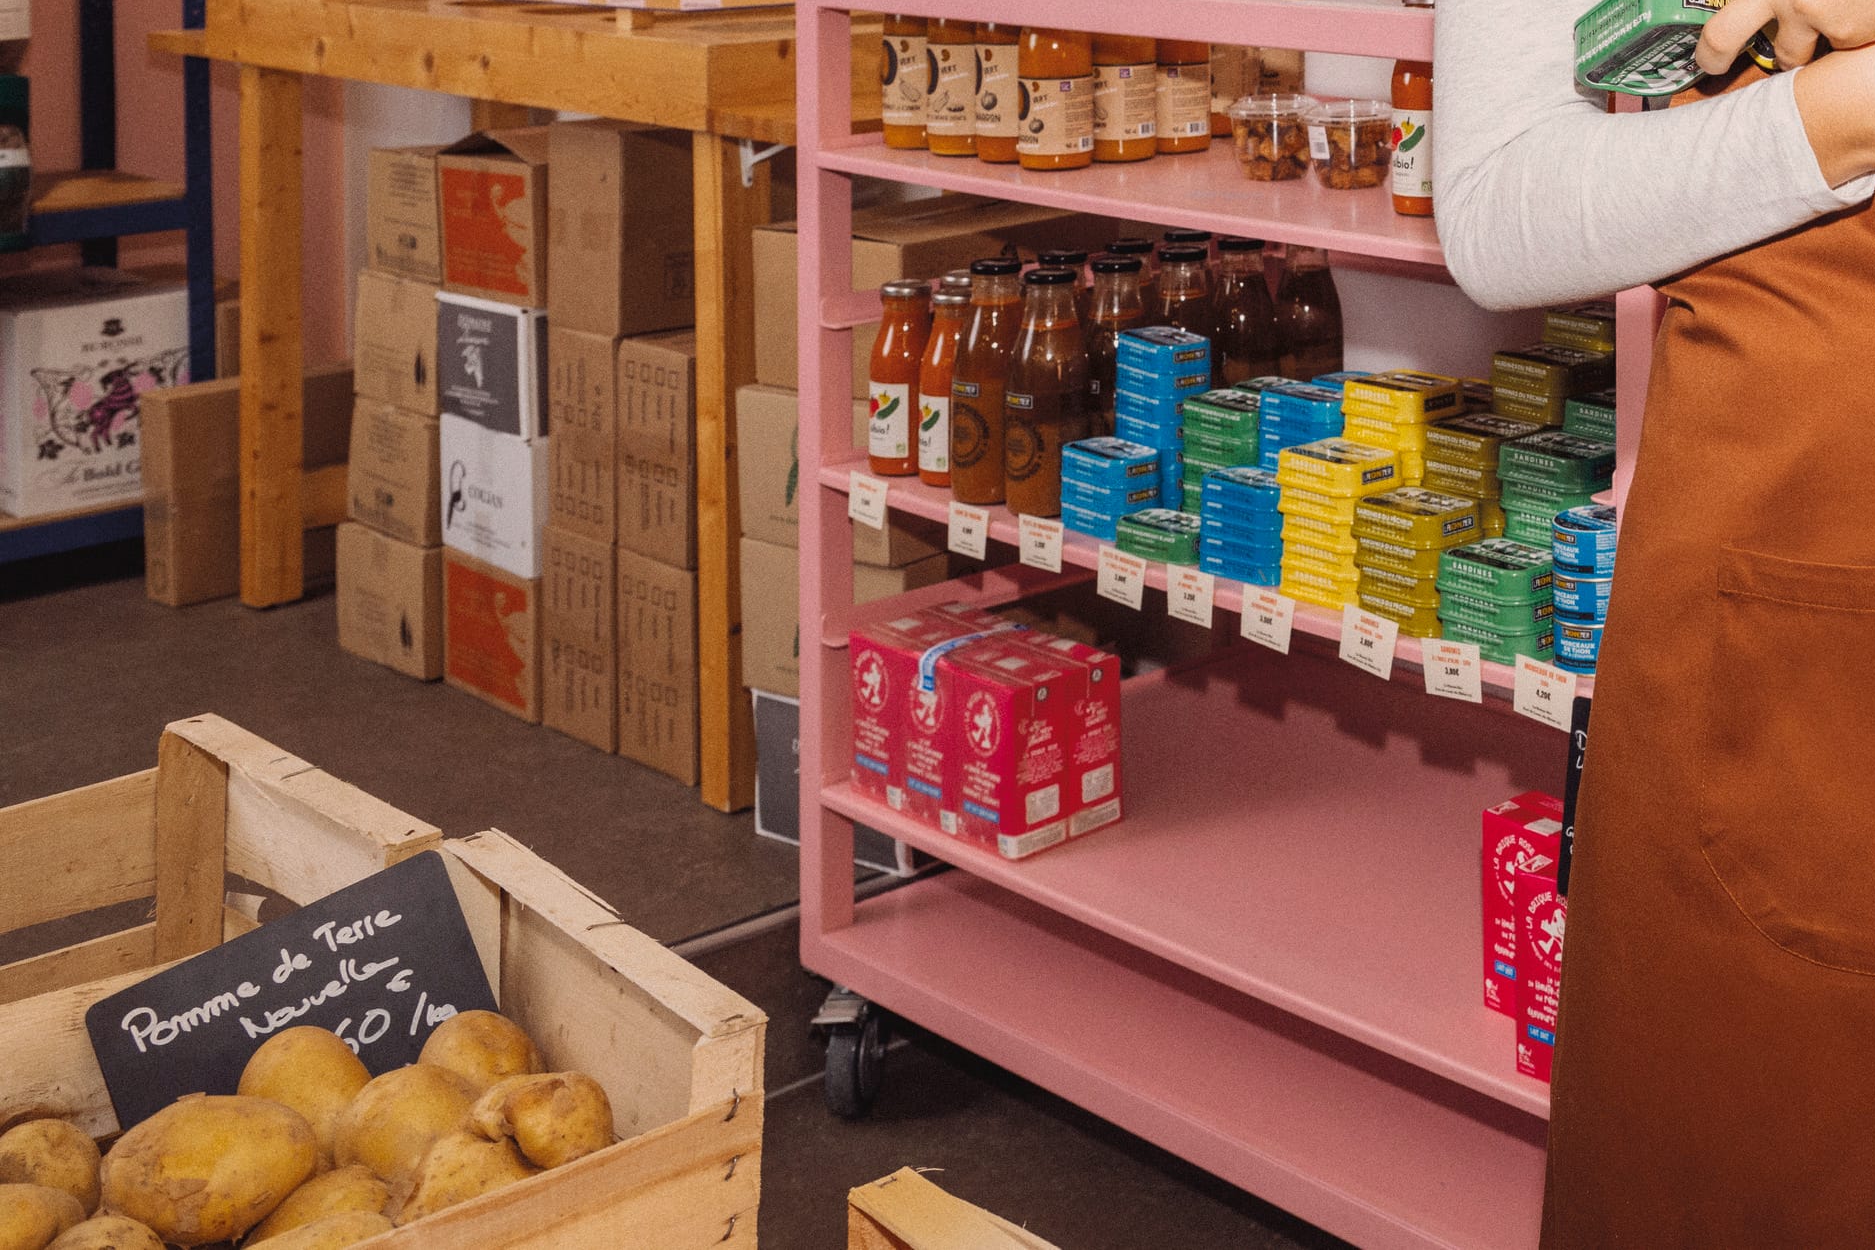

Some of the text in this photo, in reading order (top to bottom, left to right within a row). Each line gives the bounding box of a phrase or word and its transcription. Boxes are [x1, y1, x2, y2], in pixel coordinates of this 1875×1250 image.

[1514, 452, 1555, 468] SARDINES
[1452, 561, 1493, 579] SARDINES
[121, 909, 403, 1052] Pomme de Terre
